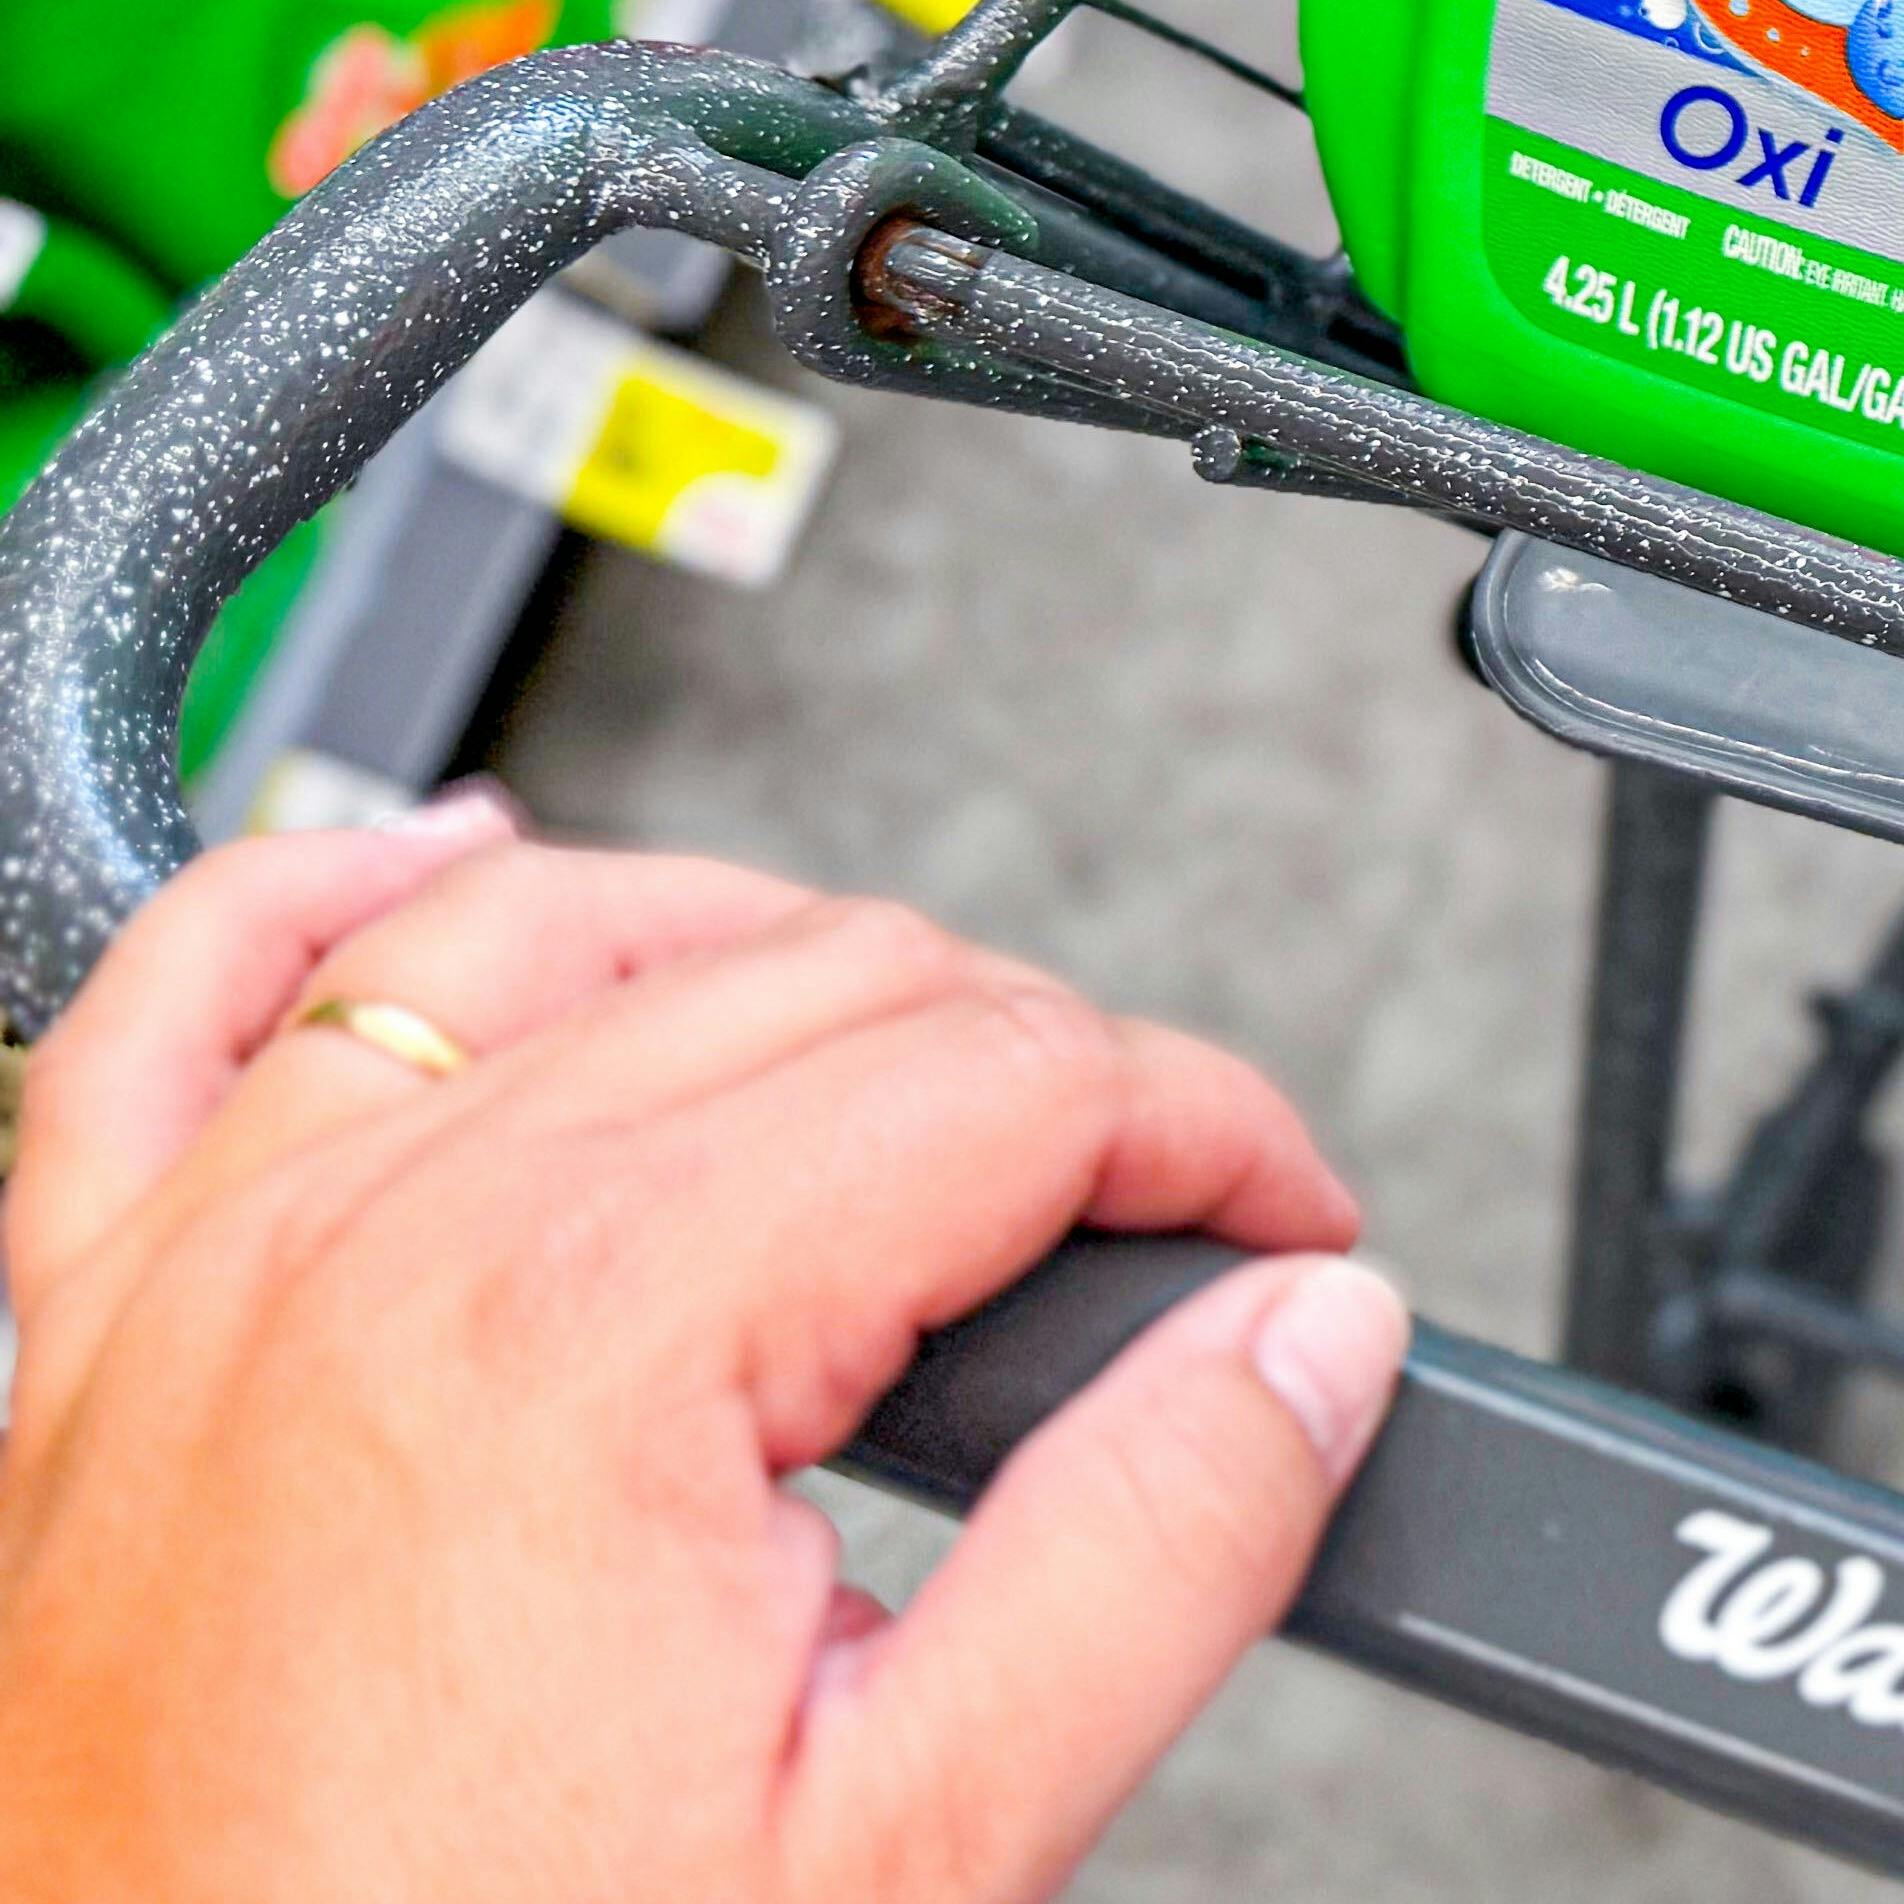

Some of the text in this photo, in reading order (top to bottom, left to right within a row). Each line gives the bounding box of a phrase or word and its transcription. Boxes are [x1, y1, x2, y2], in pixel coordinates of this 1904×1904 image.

[1509, 150, 1692, 240] DETERGENT DÉTERGENT
[1660, 85, 1845, 208] Oxi
[1722, 223, 1806, 281] CAUTION:
[1543, 255, 1618, 324] 4.25
[1616, 281, 1640, 336] L
[1645, 288, 1726, 366] (1.12
[1726, 319, 1777, 383] US
